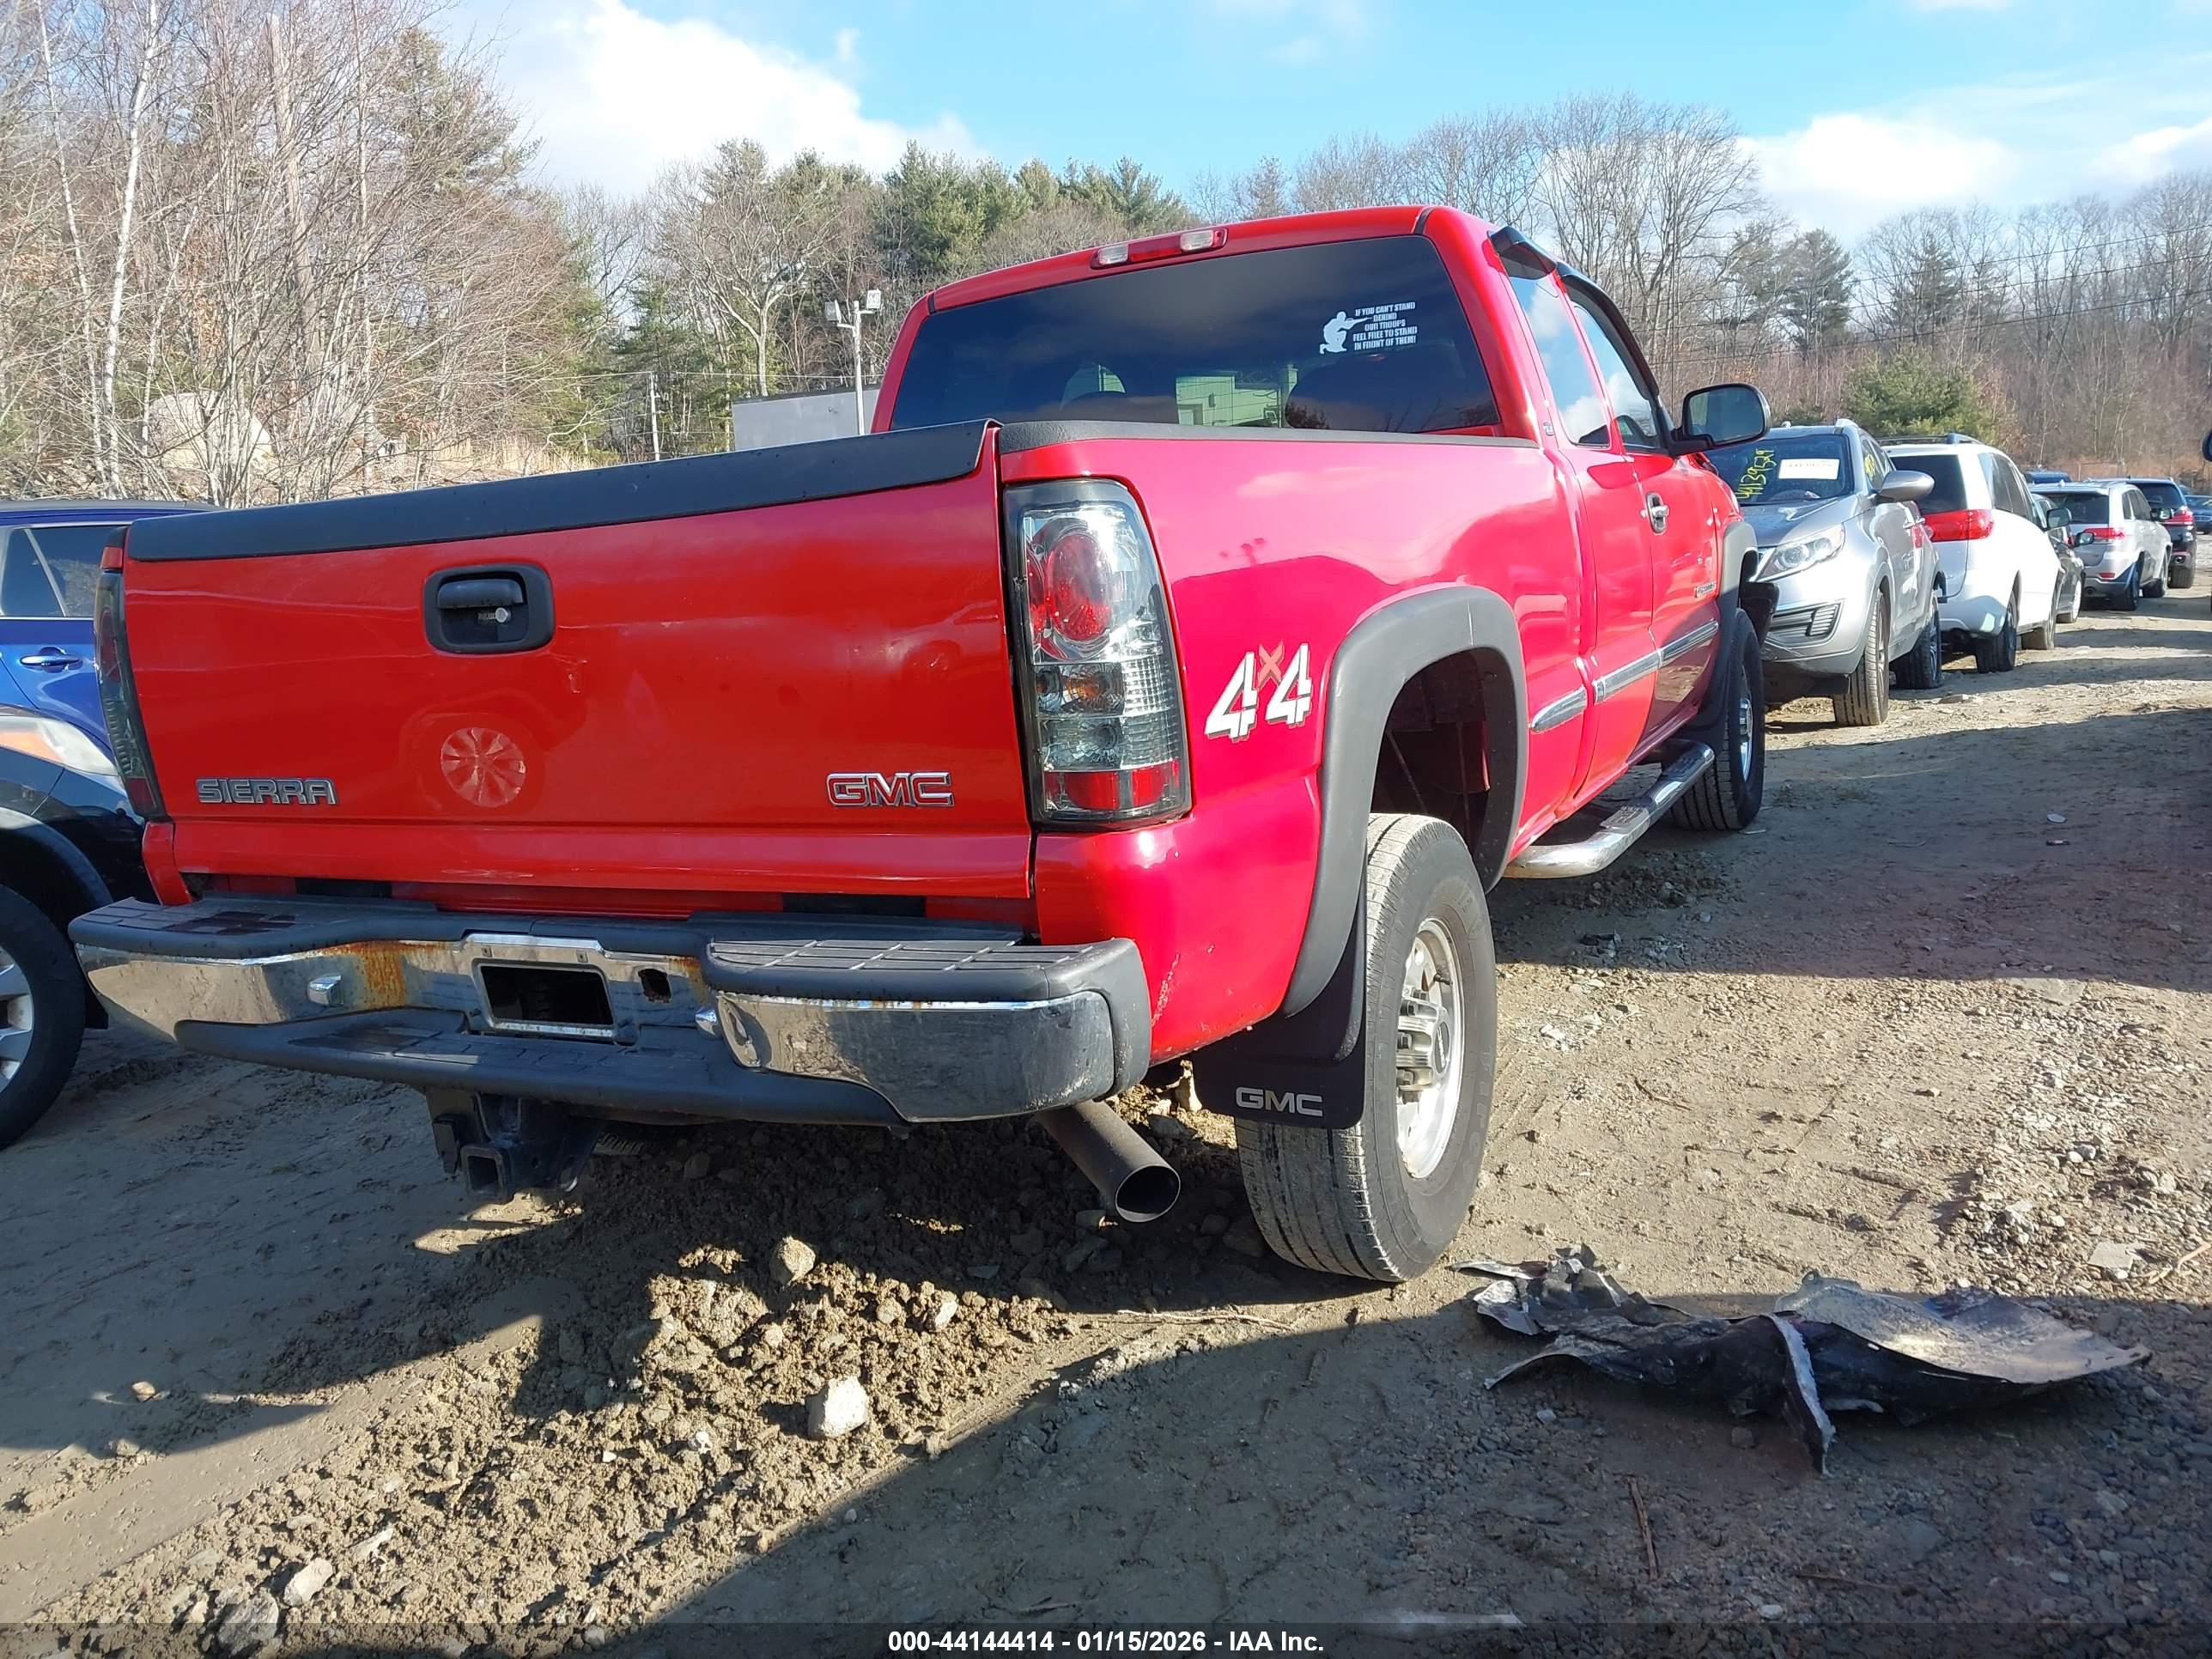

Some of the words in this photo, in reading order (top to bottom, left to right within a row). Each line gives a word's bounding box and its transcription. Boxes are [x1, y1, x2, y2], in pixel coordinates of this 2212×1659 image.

[517, 305, 535, 313] CAN'T
[536, 302, 557, 311] STAND
[506, 323, 520, 331] OUR
[520, 319, 547, 329] TROOPS
[495, 333, 508, 342] FEEL
[509, 331, 525, 339] FREE
[526, 329, 536, 337] TO
[536, 326, 559, 336] STAND
[495, 342, 503, 350] IN
[504, 339, 526, 349] FRONT
[537, 336, 557, 345] THEM!
[195, 777, 337, 805] SIERRA
[826, 771, 956, 807] GMC
[1236, 1086, 1323, 1117] GMC
